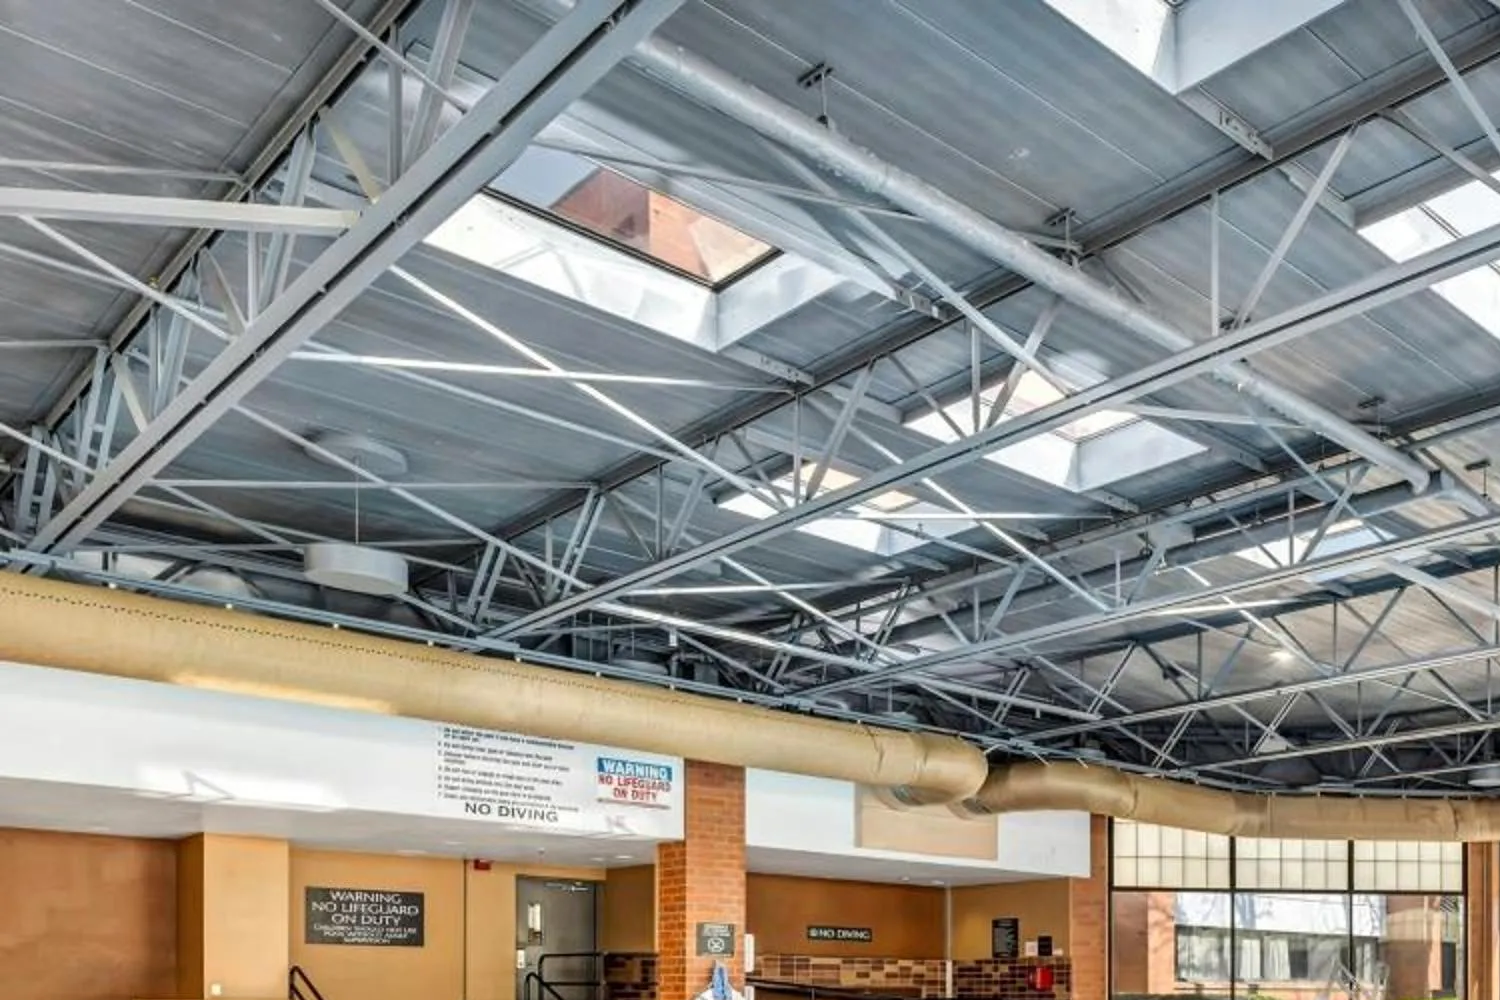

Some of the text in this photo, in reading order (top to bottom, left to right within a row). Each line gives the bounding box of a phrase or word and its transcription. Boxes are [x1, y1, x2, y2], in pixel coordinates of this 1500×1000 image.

[602, 760, 668, 779] WARNING
[598, 774, 671, 792] NO LIFEGUARD
[613, 787, 657, 802] ON DUTY
[464, 802, 491, 815] NO
[498, 805, 558, 822] DIVING
[329, 890, 401, 904] WARNING
[311, 901, 419, 916] NO LIFEGUARD
[331, 913, 401, 926] ON DUTY
[820, 929, 834, 938] NO
